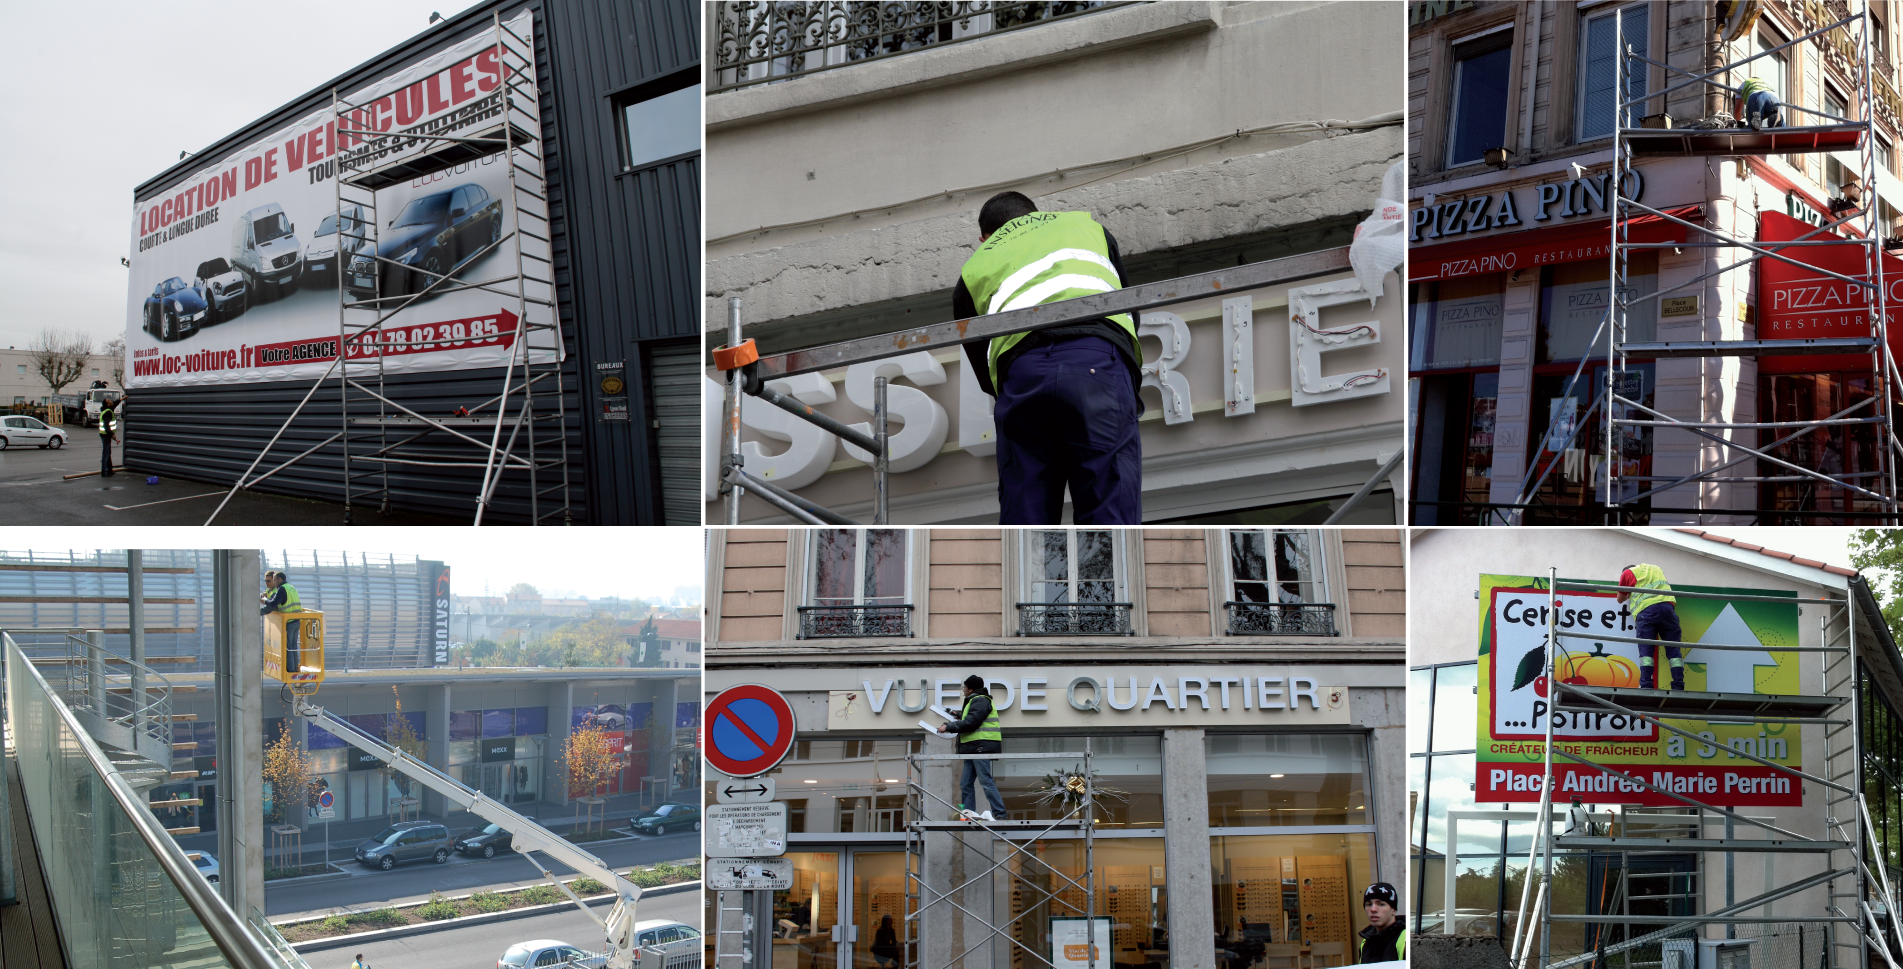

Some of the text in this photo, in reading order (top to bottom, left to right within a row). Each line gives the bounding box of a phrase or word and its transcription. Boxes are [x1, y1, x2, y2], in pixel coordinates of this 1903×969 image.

[140, 46, 511, 237] LOCATION DE VEHICULES
[308, 137, 388, 185] TOURISMES
[1408, 168, 1644, 241] PIZZA PINO
[139, 207, 219, 252] COURTE & LONGUE DUREE
[984, 213, 1058, 250] ENSEIGNES
[1535, 244, 1612, 263] RESTAURAN
[1568, 292, 1602, 307] PIZZA
[1664, 305, 1694, 314] BELLECOUR
[1773, 285, 1842, 310] PIZZA
[1441, 304, 1500, 321] PIZZA PINO
[1773, 314, 1895, 330] RESTAURN
[261, 318, 499, 363] Votre AGENCE 04 78 02 39 85
[134, 344, 254, 376] www.loc-voiture.fr
[1503, 599, 1592, 628] Cerise
[435, 599, 448, 663] SATURN
[862, 675, 1321, 714] VUE DE QUARTIER
[1564, 745, 1581, 755] DE
[1586, 743, 1659, 757] FRAÎCHEUR
[1666, 731, 1788, 760] à 3 min
[1652, 771, 1717, 794] Marie
[1724, 772, 1791, 795] Perrin
